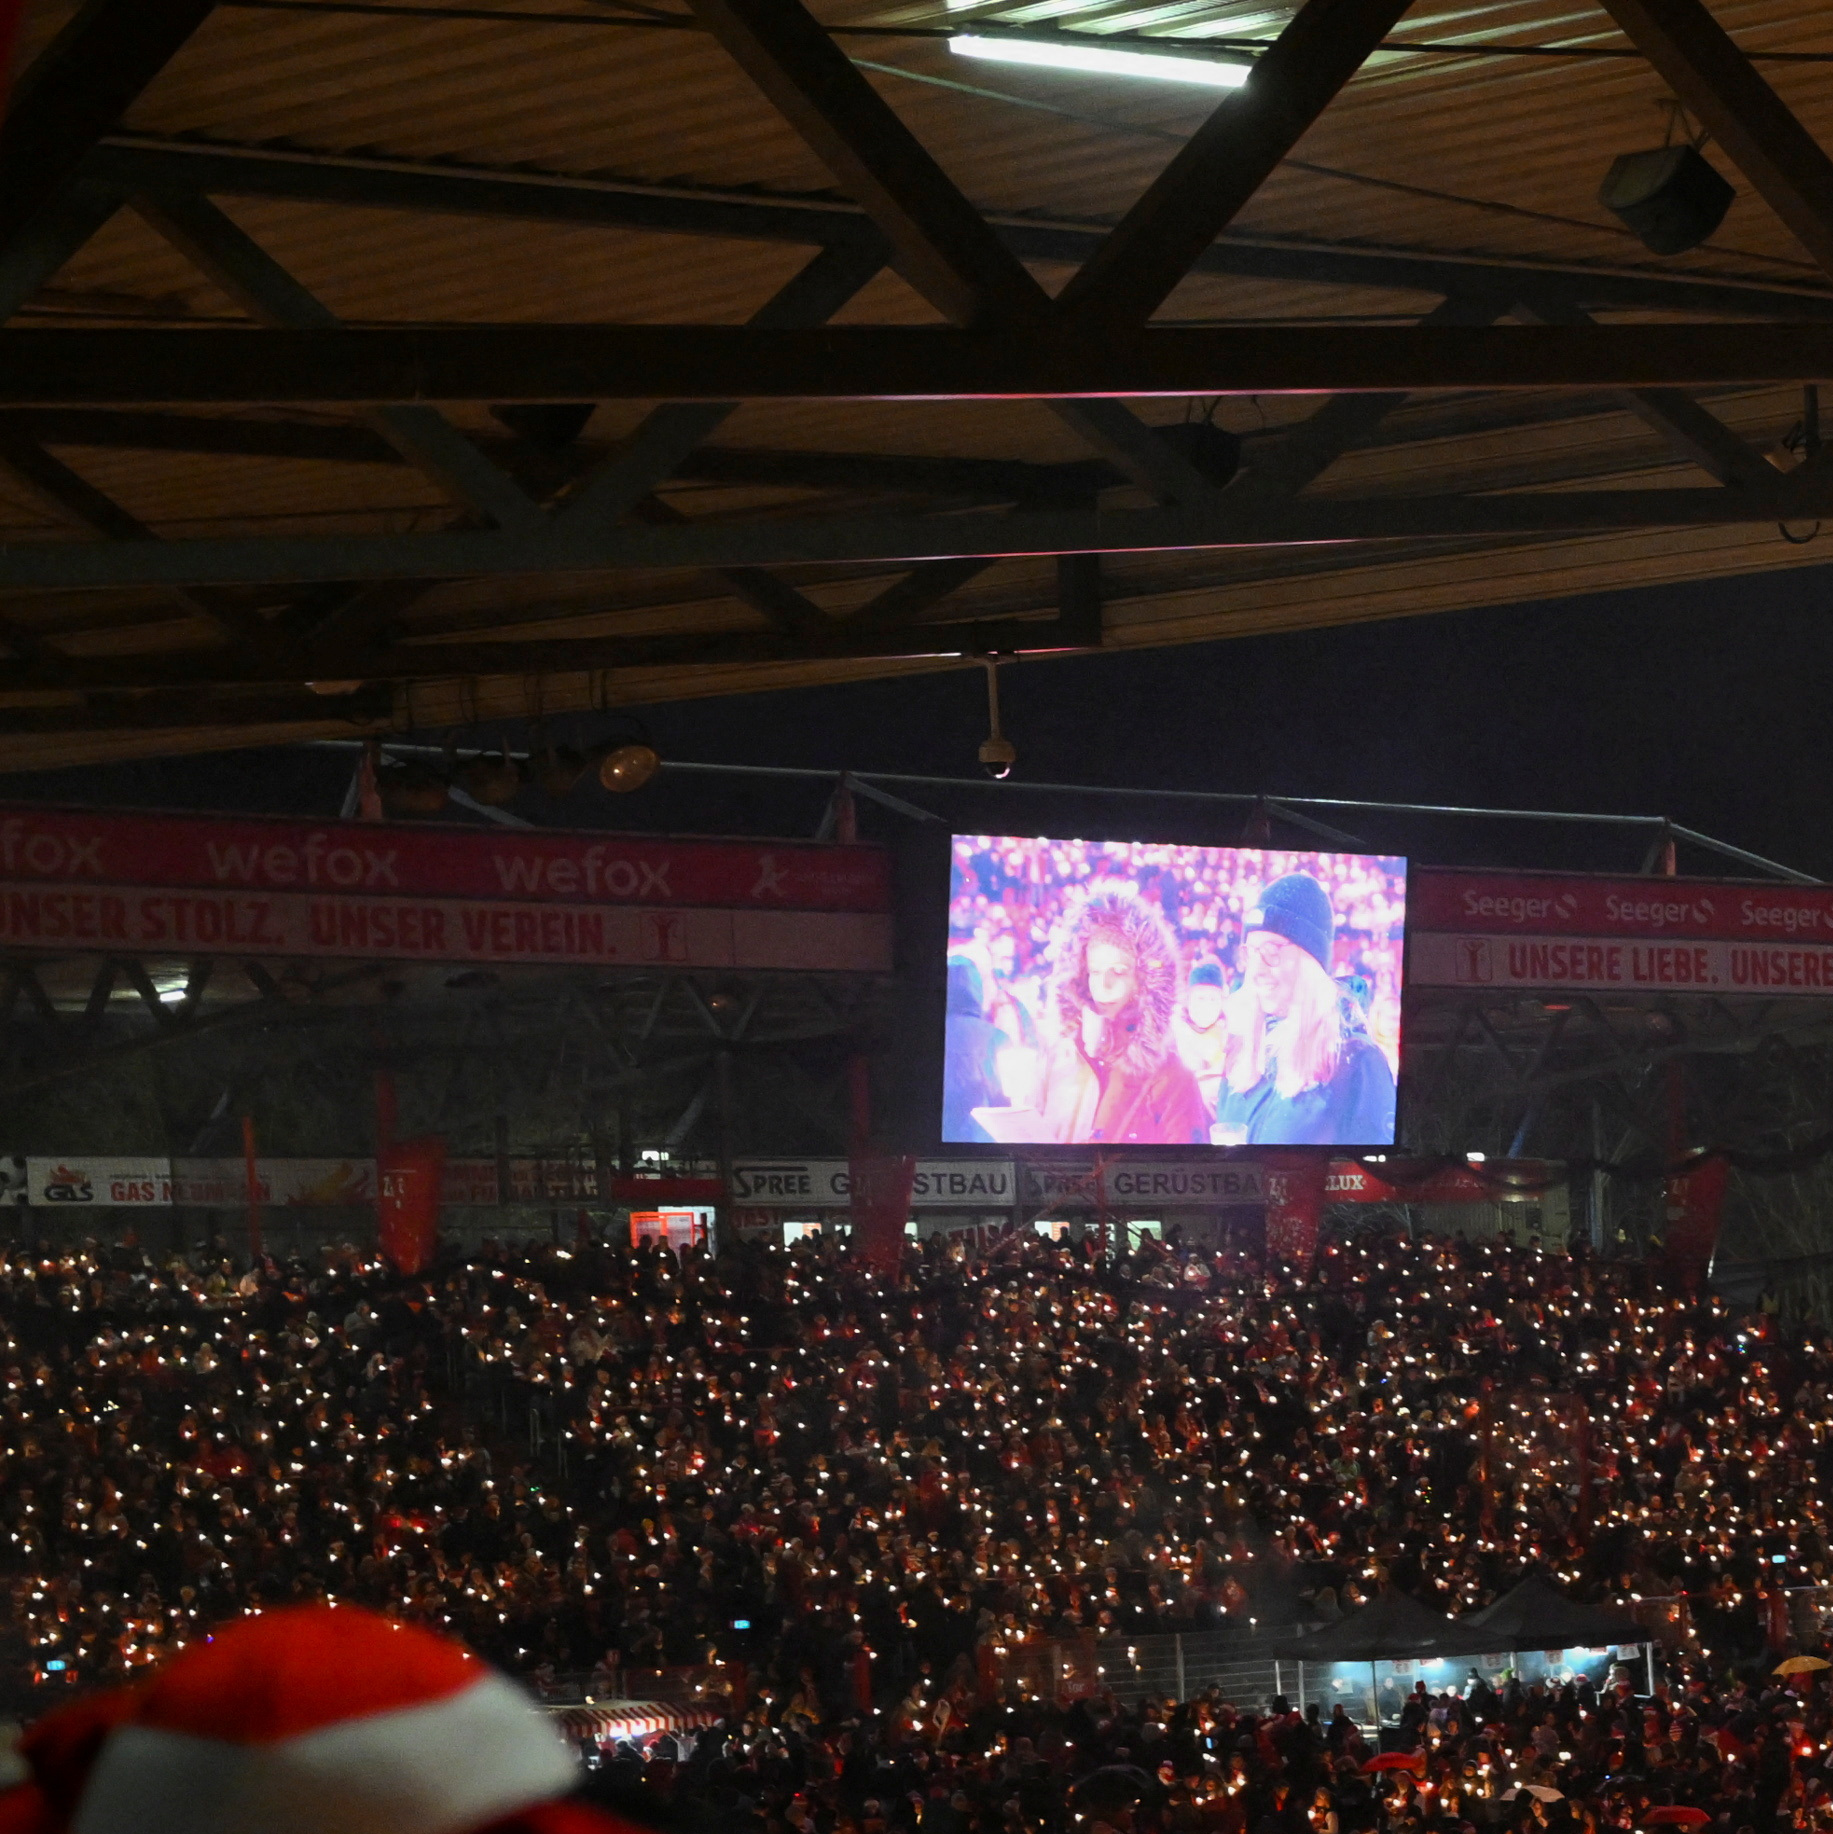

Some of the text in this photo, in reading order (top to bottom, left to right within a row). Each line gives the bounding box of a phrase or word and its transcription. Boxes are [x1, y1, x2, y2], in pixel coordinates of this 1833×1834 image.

[0, 818, 101, 874] fox
[206, 832, 399, 887] wefox
[493, 845, 672, 898] wefox
[1463, 889, 1551, 923] Seeger
[1605, 895, 1688, 927] Seeger
[1741, 900, 1820, 932] Seeger
[140, 898, 287, 946] STOLZ.
[310, 904, 447, 951] UNSER
[462, 908, 616, 955] VEREIN.
[1507, 942, 1622, 981] UNSERE
[1632, 947, 1719, 985] LIEBE.
[44, 1184, 94, 1201] GAS
[110, 1181, 155, 1201] GAS
[734, 1166, 812, 1198] SPREE
[1114, 1165, 1260, 1195] GERÜSTBA
